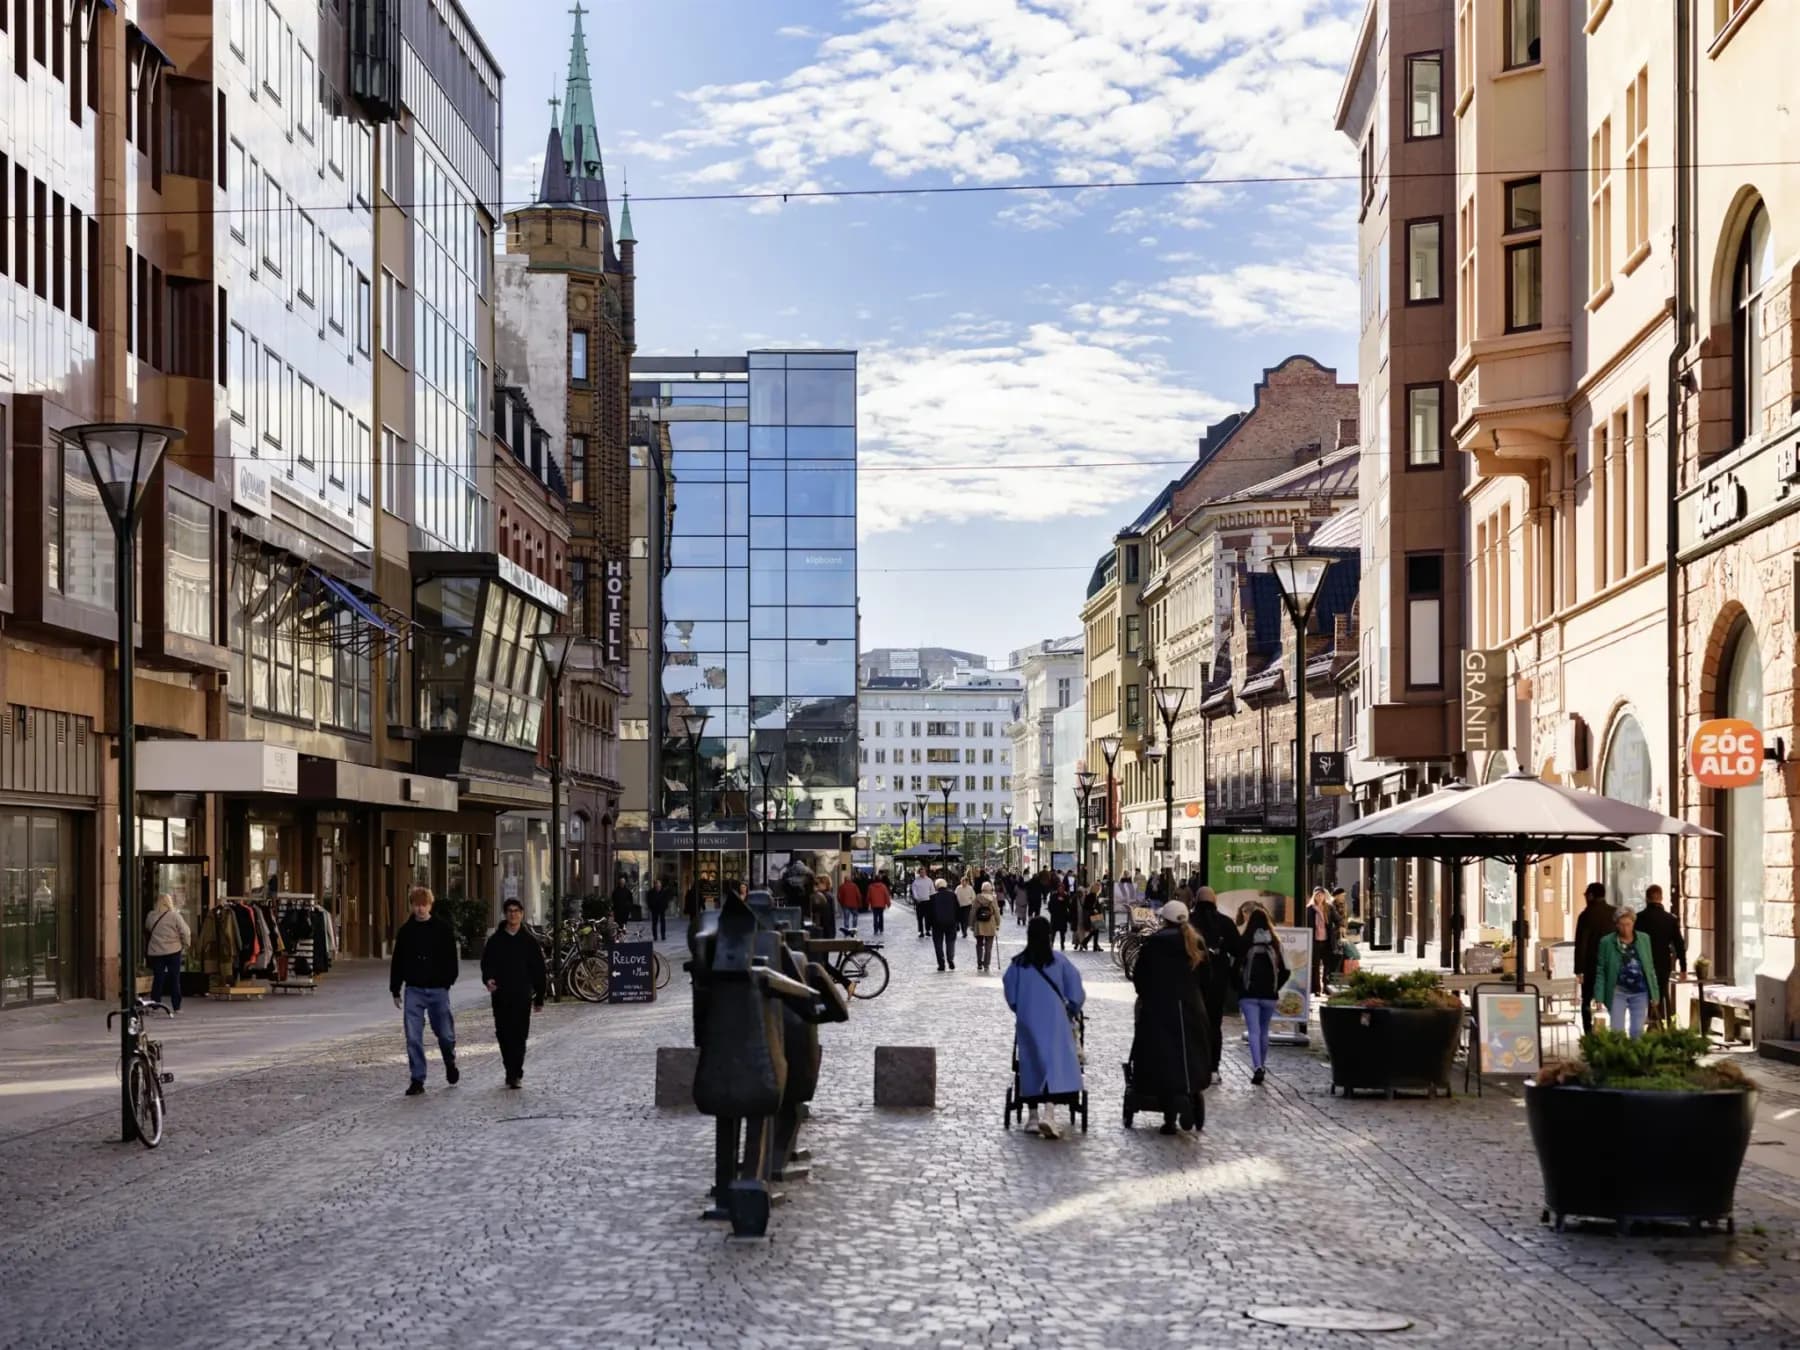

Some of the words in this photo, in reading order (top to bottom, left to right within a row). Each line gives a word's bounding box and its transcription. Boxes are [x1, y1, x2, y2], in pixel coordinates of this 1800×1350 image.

[608, 561, 622, 660] HOTELL
[1466, 652, 1487, 748] GRANIT
[1700, 727, 1755, 754] ZÓC
[1699, 756, 1755, 775] ALO
[1225, 865, 1243, 873] om
[1247, 863, 1279, 873] foder
